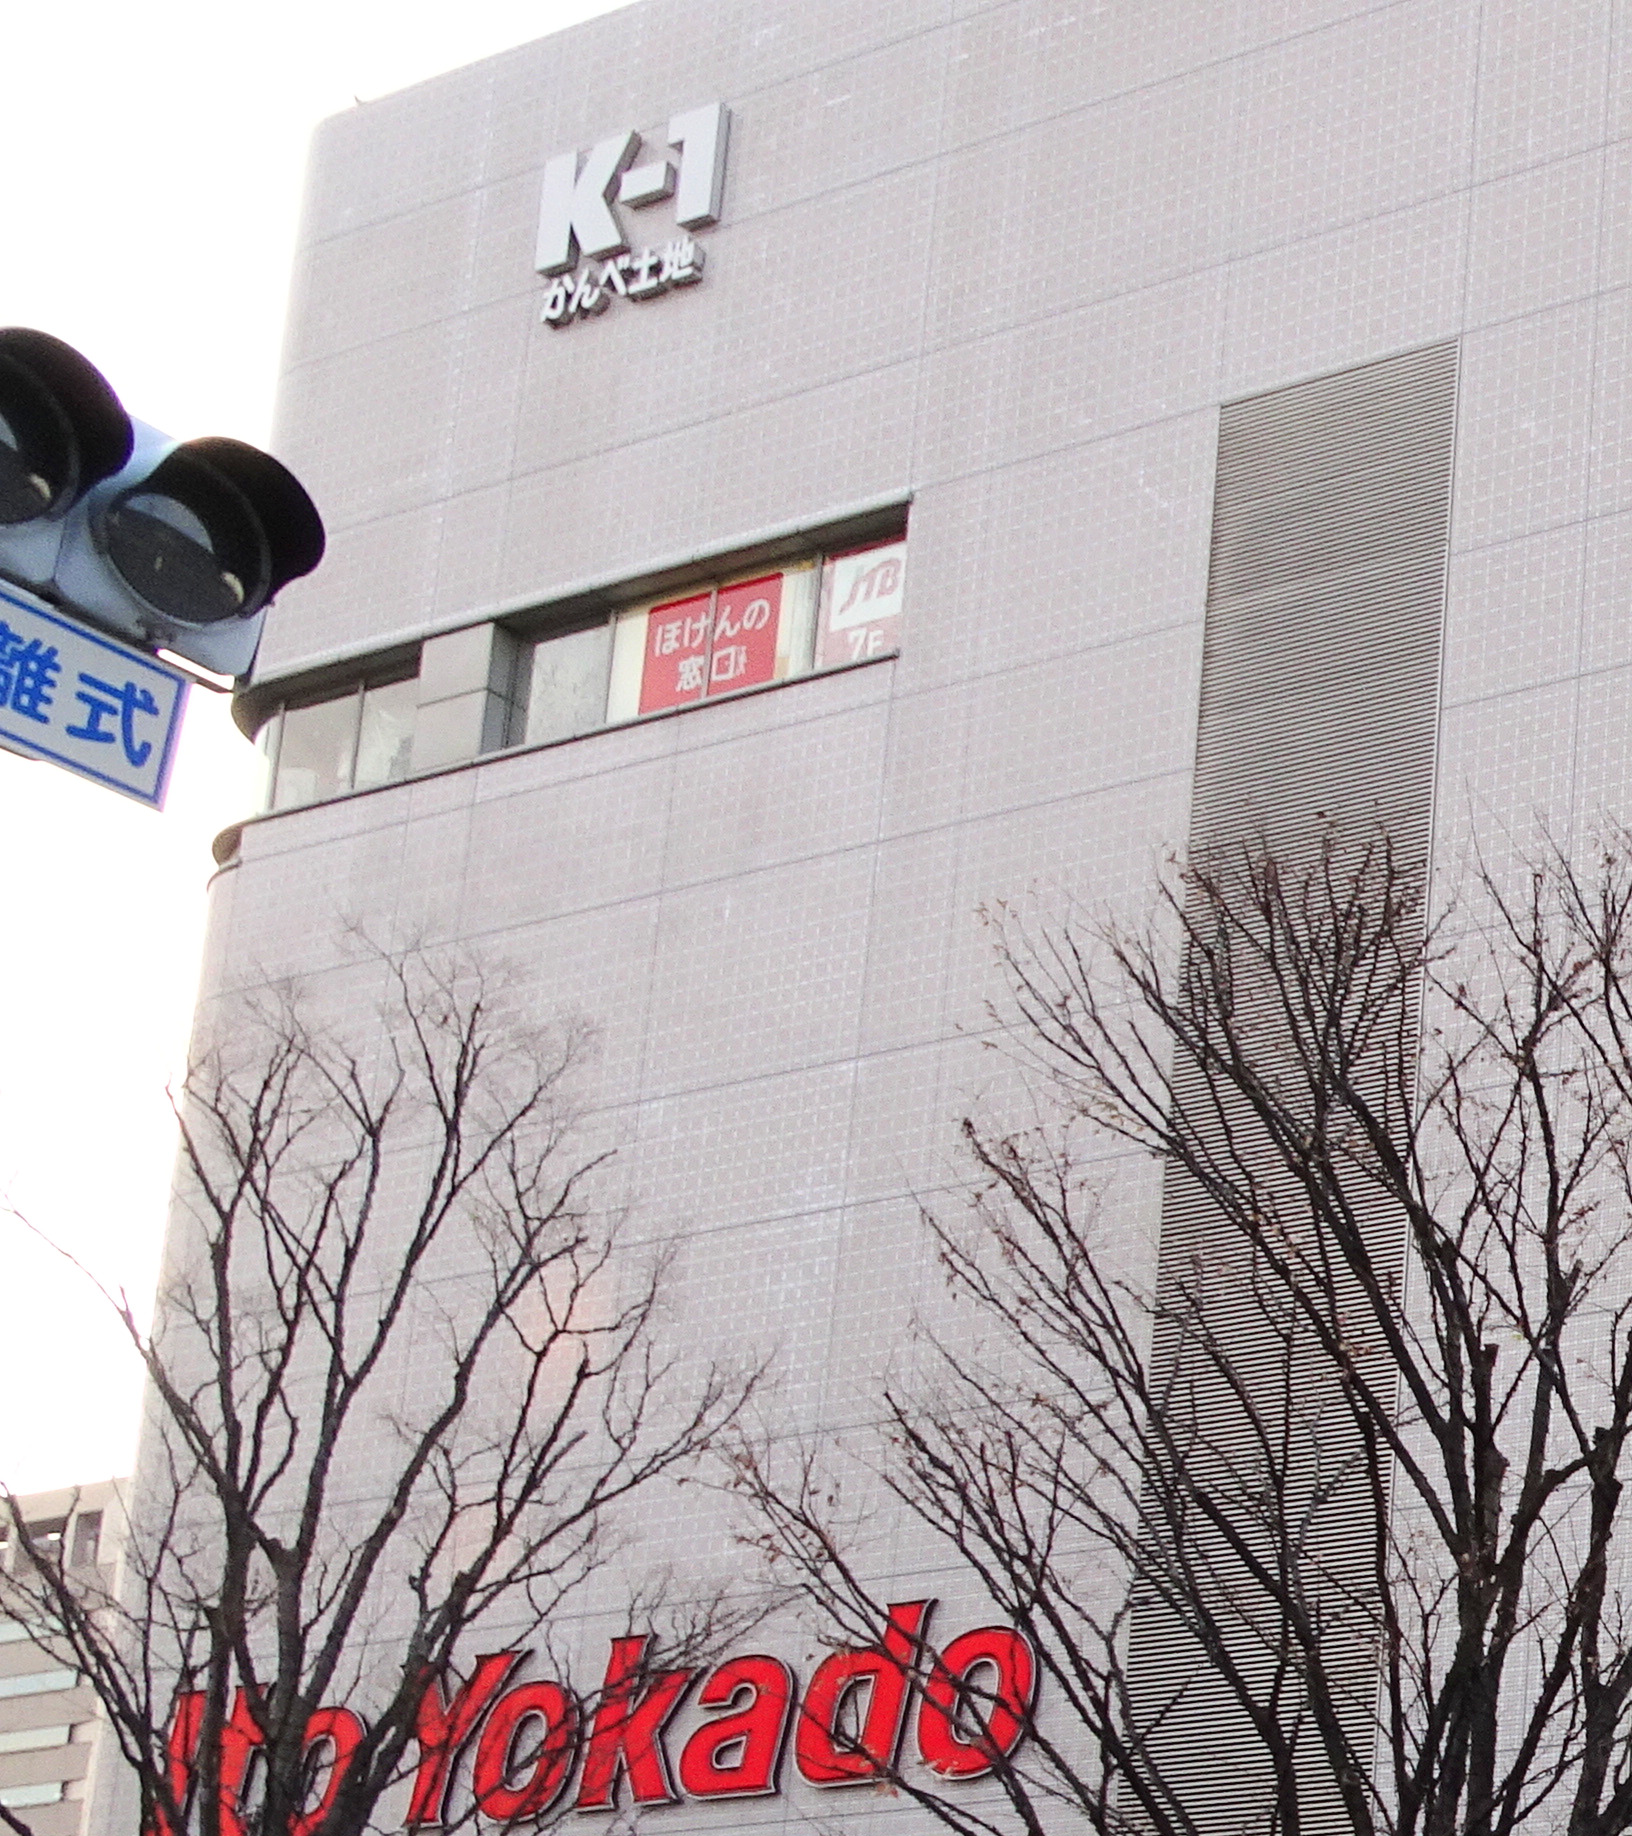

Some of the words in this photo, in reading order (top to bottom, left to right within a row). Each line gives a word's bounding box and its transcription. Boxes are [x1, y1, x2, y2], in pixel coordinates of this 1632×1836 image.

[534, 102, 731, 279] K-1
[541, 234, 706, 329] かんべ土地
[654, 598, 770, 657] ほけんの
[848, 627, 885, 662] 7F
